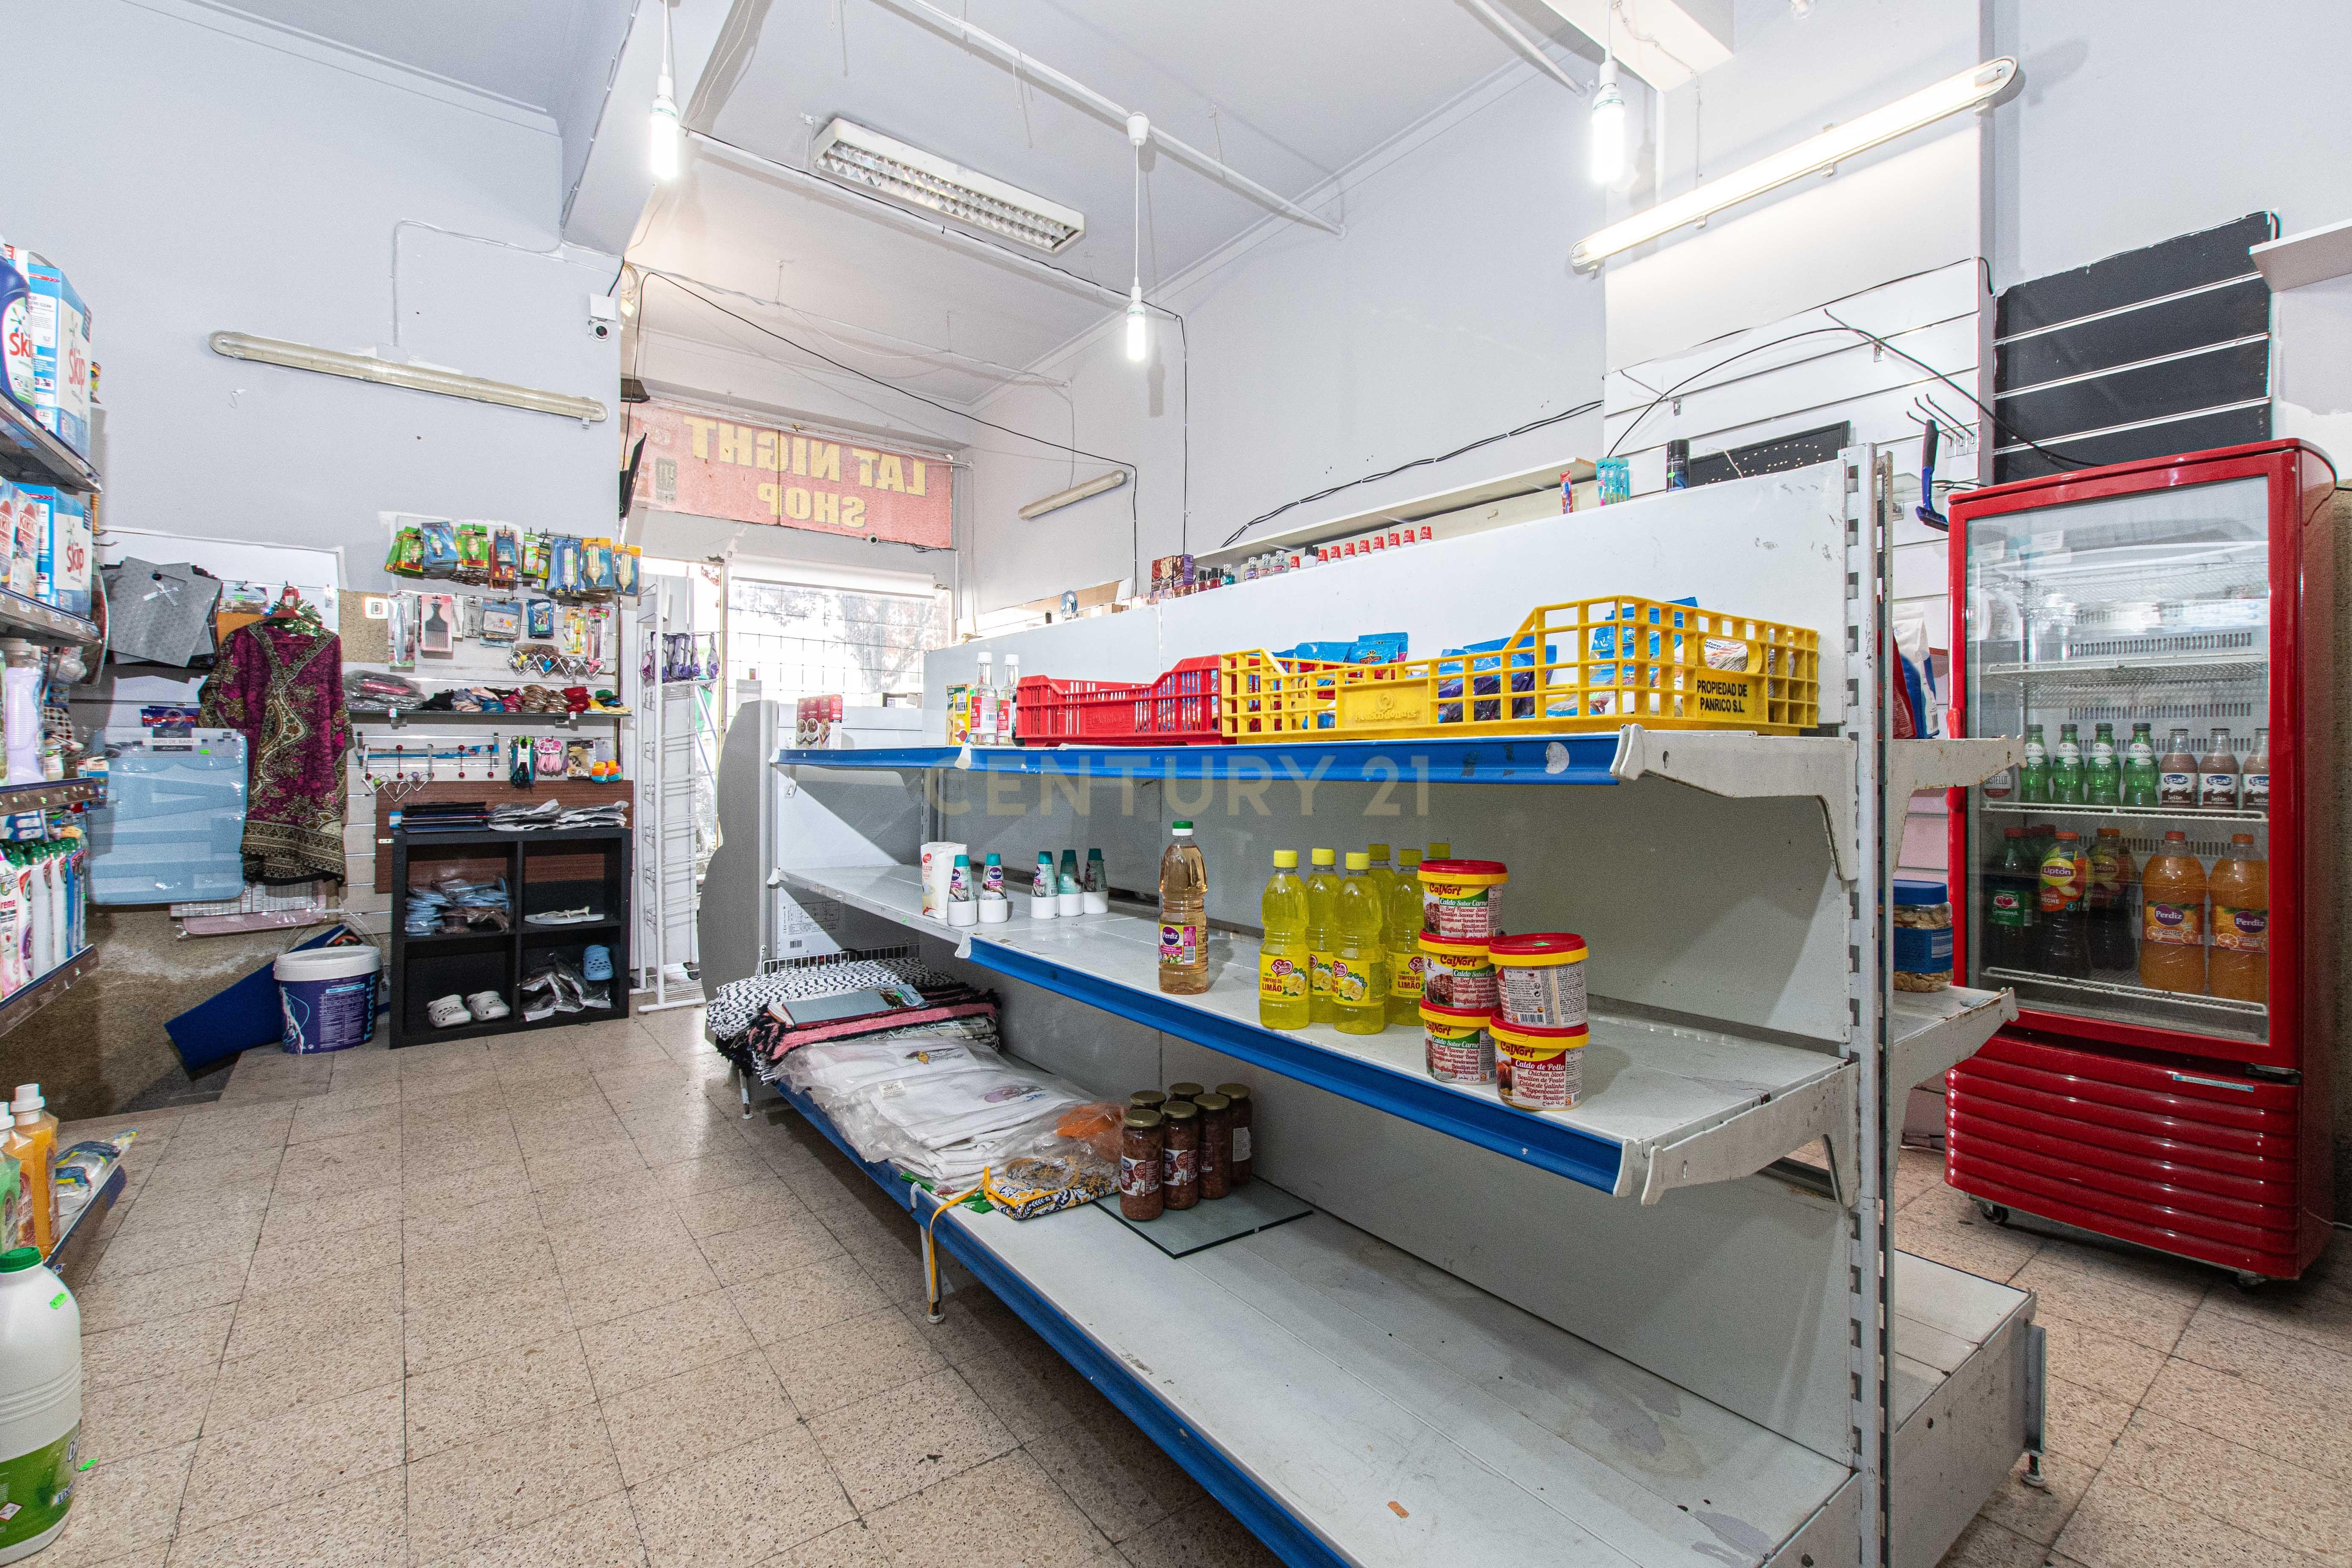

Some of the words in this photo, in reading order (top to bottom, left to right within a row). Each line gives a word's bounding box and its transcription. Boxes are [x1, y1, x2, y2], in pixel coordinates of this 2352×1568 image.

[9, 333, 33, 358] Ski
[1697, 680, 1736, 697] PROPIEDAD
[1738, 684, 1747, 697] DE
[1700, 697, 1731, 712] PANRICO
[1733, 700, 1745, 713] S.L.
[1430, 883, 1462, 896] CalNort
[0, 900, 16, 909] reme
[2156, 910, 2182, 919] Perdiz
[2236, 918, 2265, 927] Perdiz
[1440, 955, 1476, 967] CalNort
[1263, 983, 1282, 992] LIMÃO
[1398, 981, 1420, 989] LIMÃO
[1425, 1020, 1451, 1036] CalNort
[1433, 1036, 1446, 1045] Caldo
[1500, 1041, 1535, 1058] CalNort
[1515, 1060, 1535, 1069] Caldo
[1517, 1074, 1539, 1082] Bouillon
[1522, 1092, 1541, 1100] Hühner
